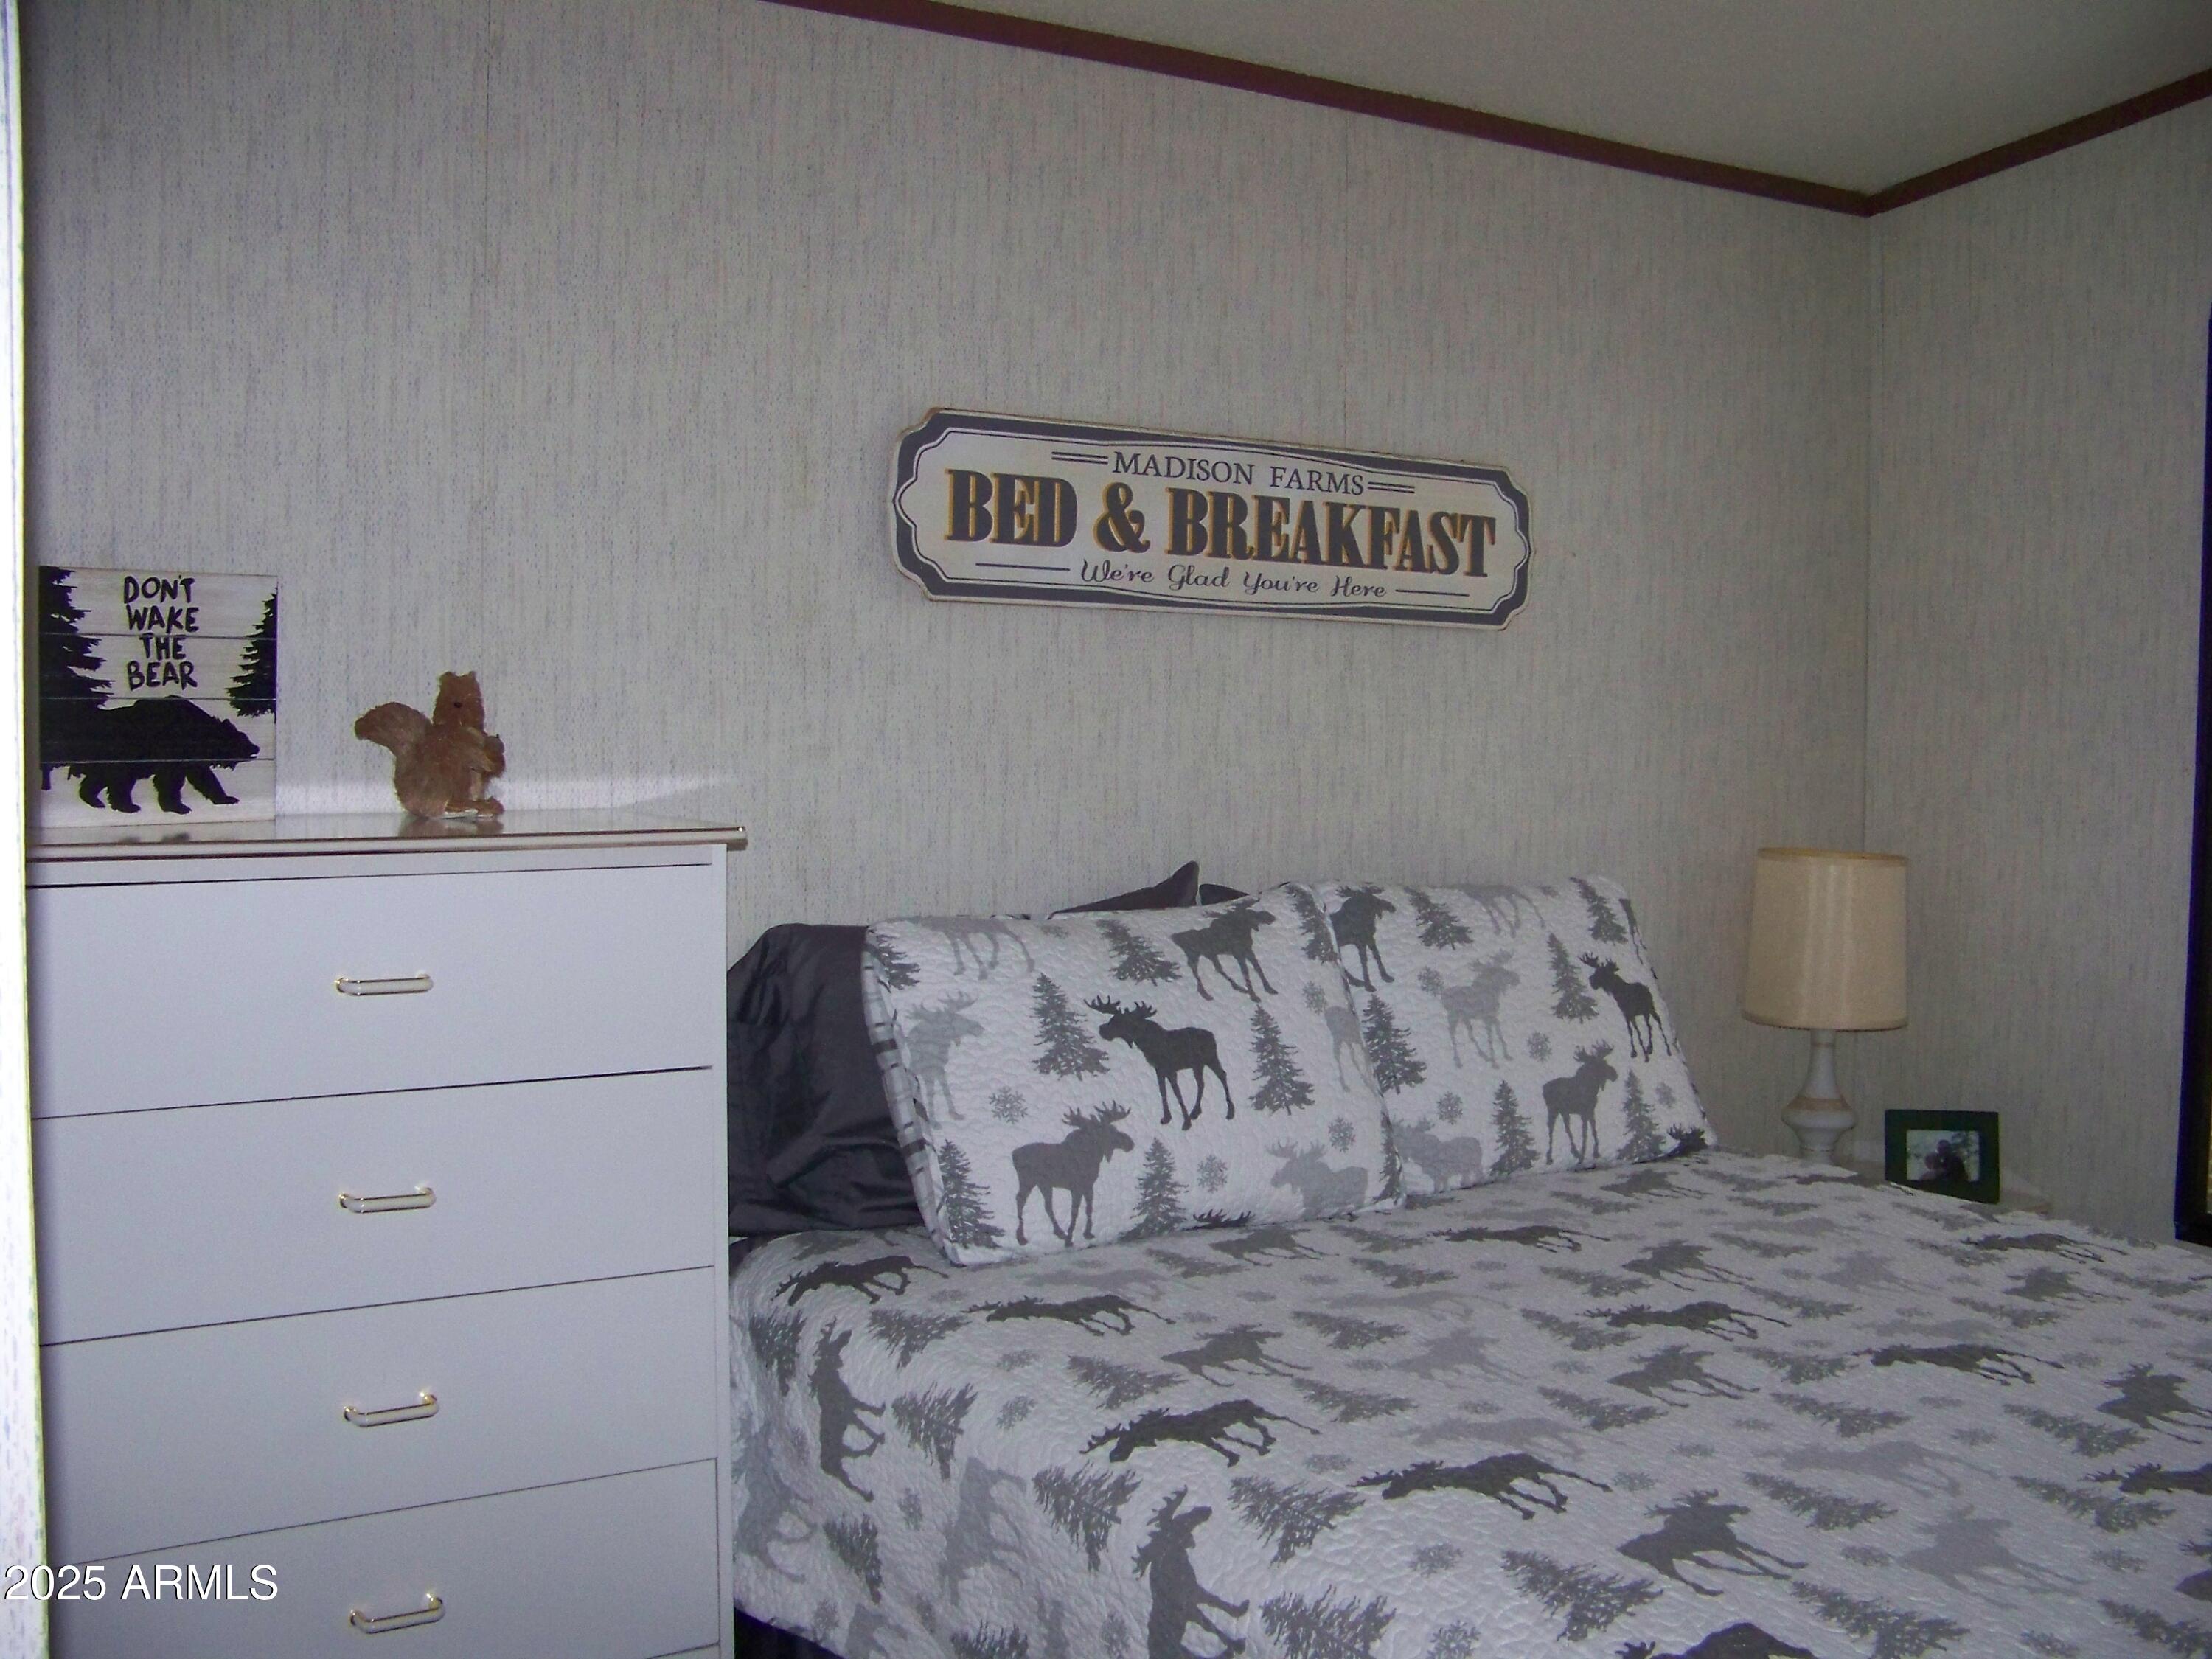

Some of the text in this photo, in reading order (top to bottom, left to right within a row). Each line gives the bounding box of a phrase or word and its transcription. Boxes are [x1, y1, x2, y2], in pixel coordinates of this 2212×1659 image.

[1113, 451, 1364, 495] MADISON FARMS
[944, 468, 1497, 578] BED & BREAKFAST
[123, 574, 195, 604] DON'T
[1080, 559, 1387, 598] We're Glad You're Here
[125, 605, 200, 634] WAKE
[139, 632, 187, 661] THE
[127, 660, 198, 691] BEAR
